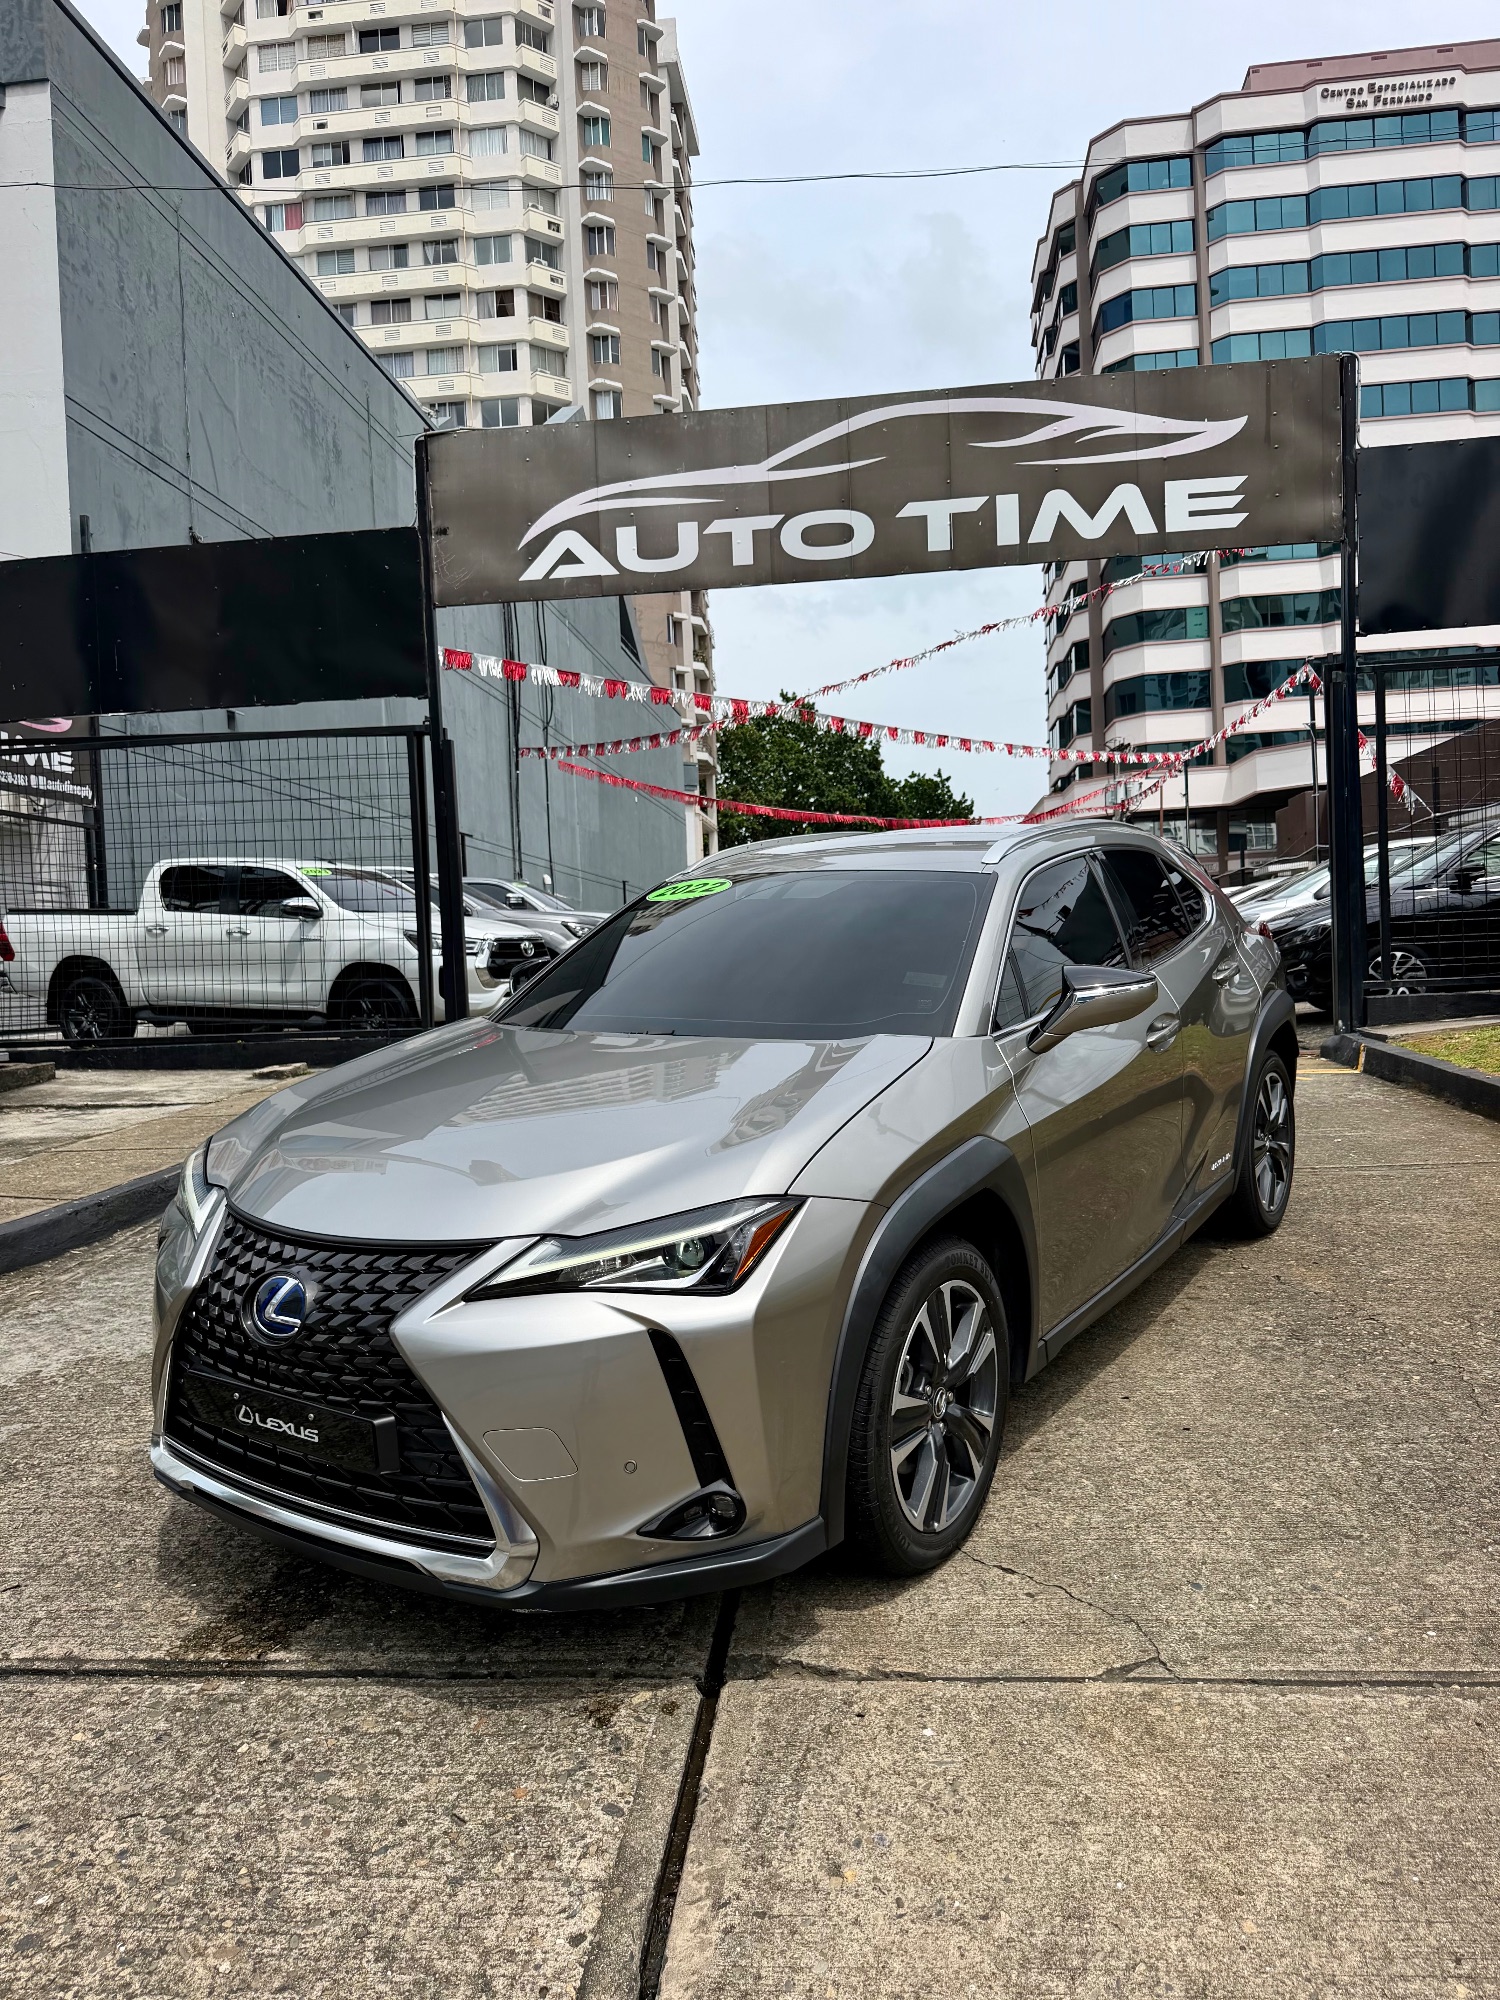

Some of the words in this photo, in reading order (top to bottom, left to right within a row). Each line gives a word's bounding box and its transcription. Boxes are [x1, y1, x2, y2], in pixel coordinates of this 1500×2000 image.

[1320, 86, 1364, 99] CENTRO
[1367, 76, 1457, 94] ESPECIALIZADO
[1346, 97, 1368, 109] SAN
[1373, 92, 1433, 107] FERNANDO
[518, 509, 875, 582] AUTO
[895, 475, 1250, 552] TIME
[651, 881, 727, 899] 2022
[255, 1412, 319, 1443] LEXUS
